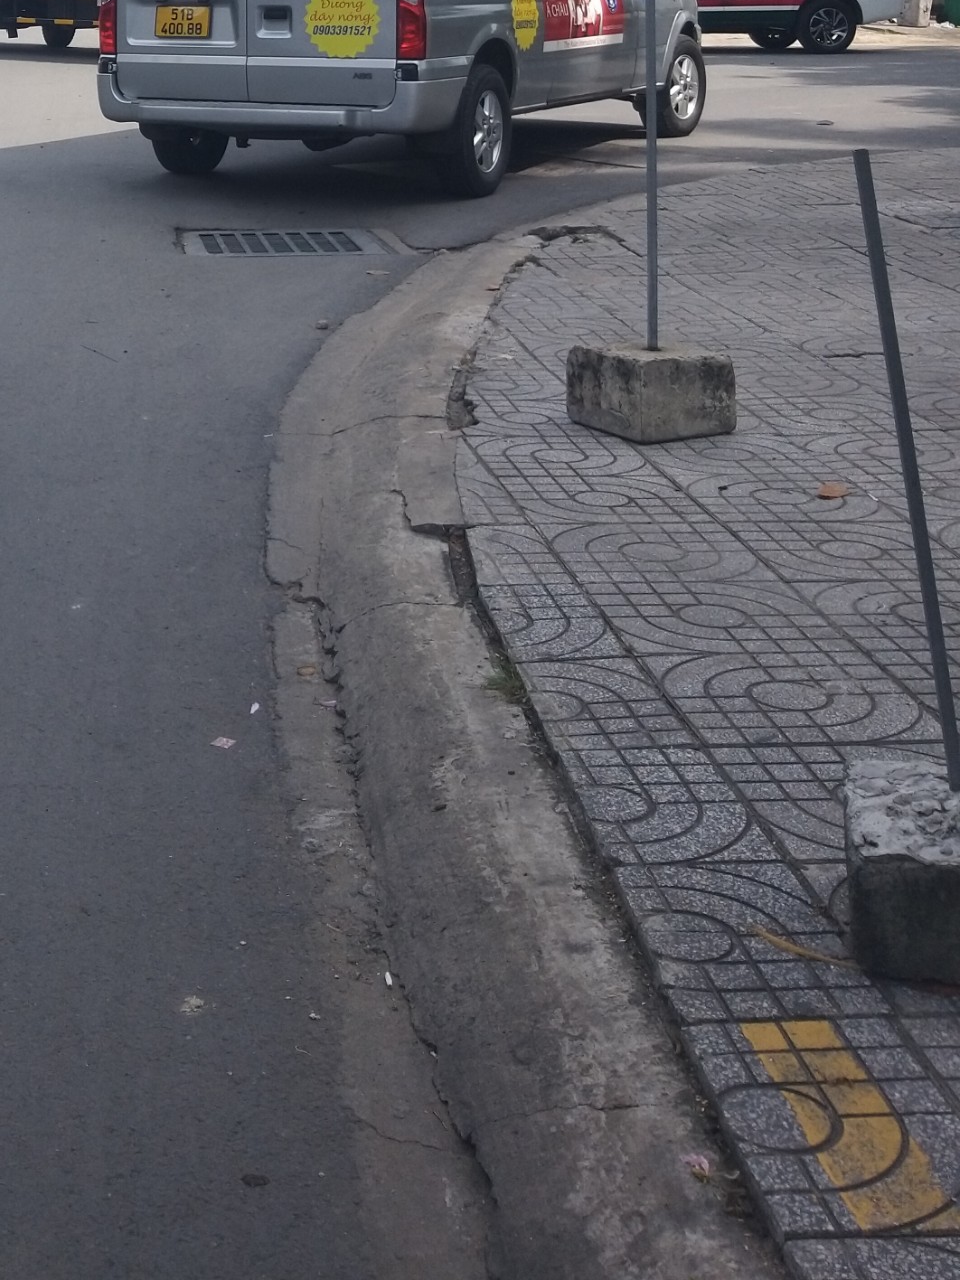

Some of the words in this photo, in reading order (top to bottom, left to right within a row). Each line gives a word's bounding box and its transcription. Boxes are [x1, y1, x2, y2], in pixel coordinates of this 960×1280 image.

[171, 8, 194, 21] 51B
[161, 22, 203, 35] 400.88
[312, 25, 372, 35] 0903391521
